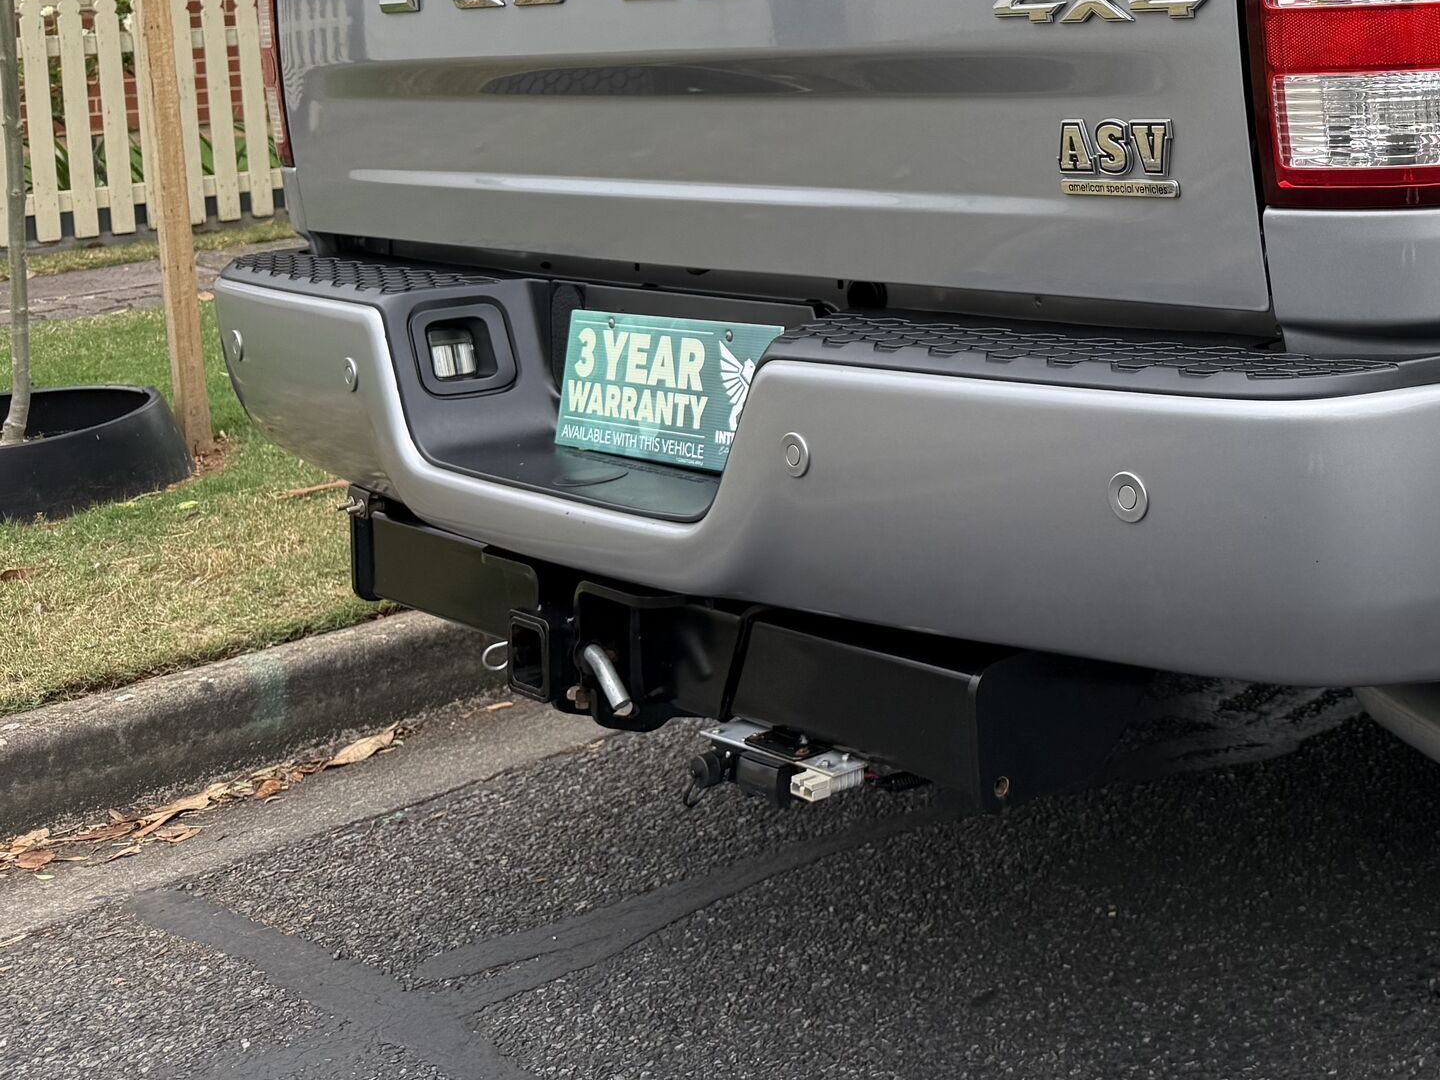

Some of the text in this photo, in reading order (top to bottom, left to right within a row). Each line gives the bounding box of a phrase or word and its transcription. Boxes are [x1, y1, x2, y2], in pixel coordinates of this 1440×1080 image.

[1056, 118, 1174, 176] ASV
[1068, 182, 1168, 196] american special vehicles
[574, 327, 704, 390] 3 YEAR
[569, 380, 707, 429] WARRANTY
[561, 424, 611, 445] AVAILABLE
[612, 431, 637, 450] WITH
[639, 435, 660, 452] THIS
[662, 439, 703, 458] VEHICLE
